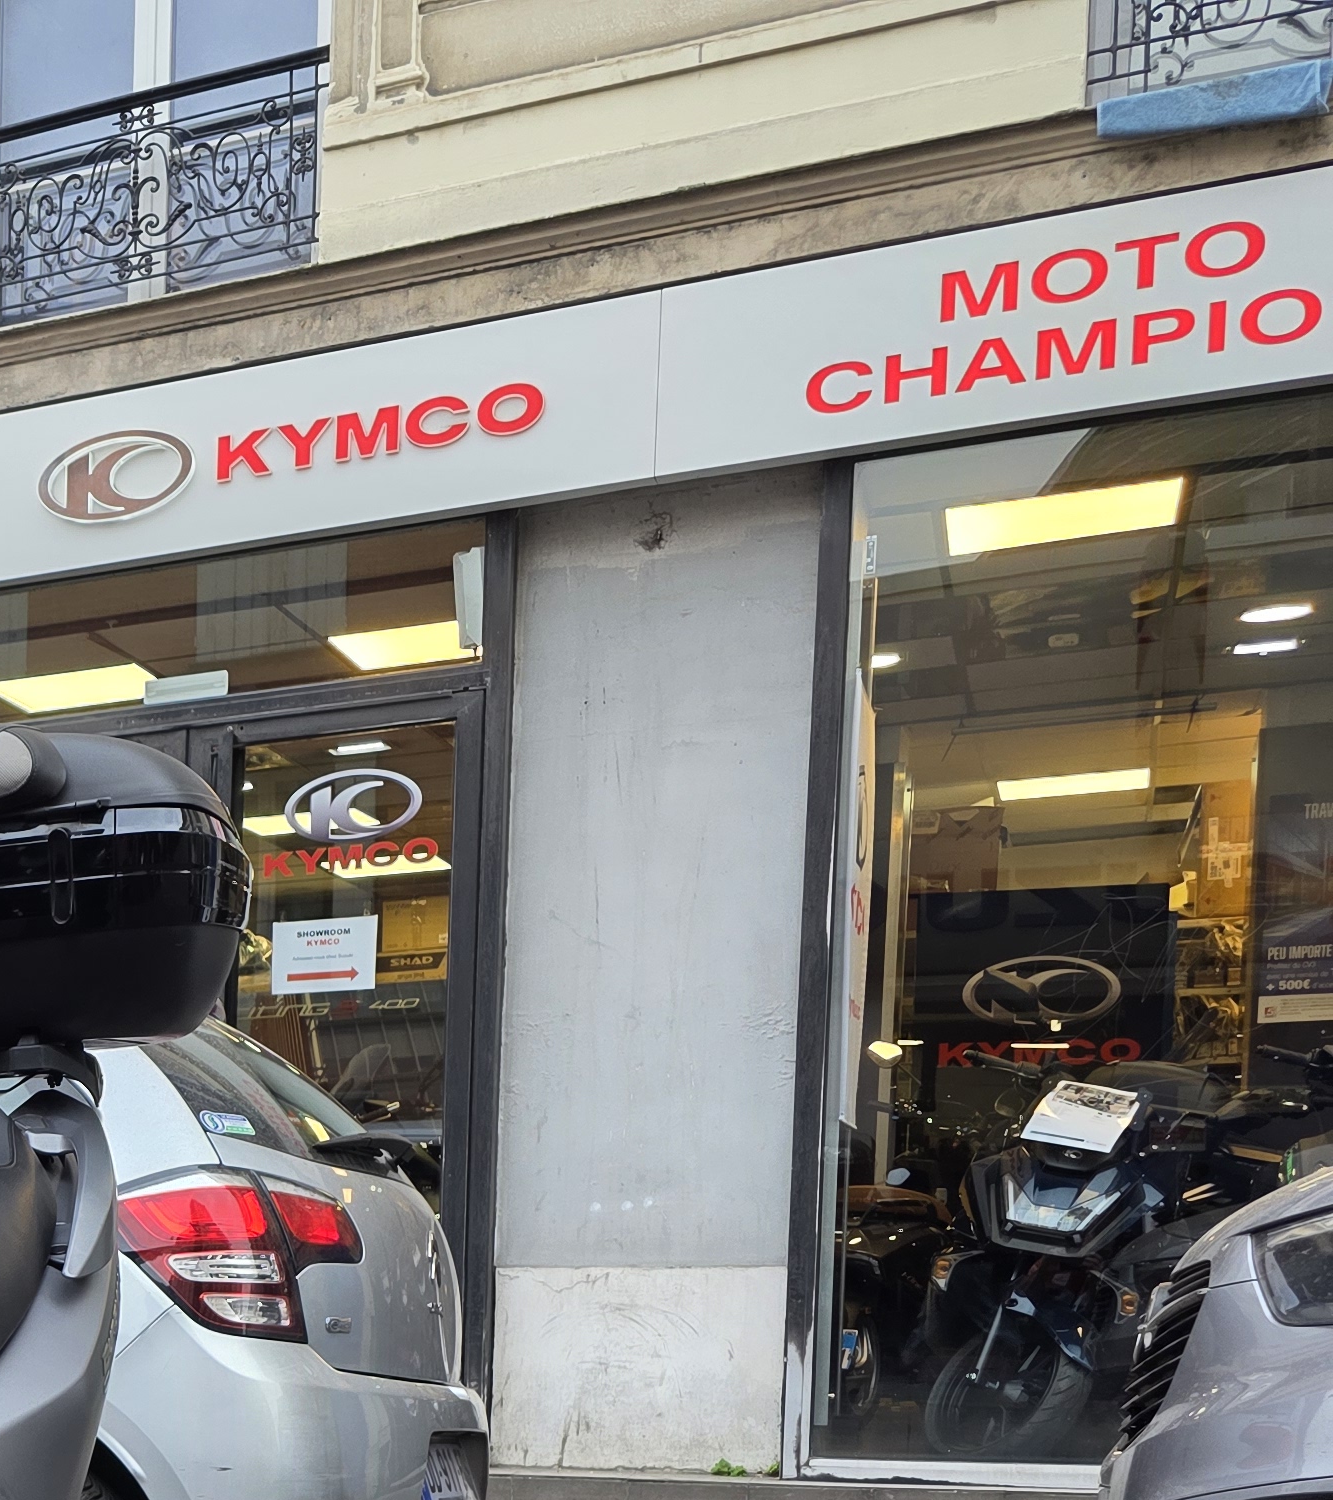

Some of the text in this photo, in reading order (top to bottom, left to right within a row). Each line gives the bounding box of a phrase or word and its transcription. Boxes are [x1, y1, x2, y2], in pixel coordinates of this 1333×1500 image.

[939, 221, 1266, 323] MOTO
[805, 288, 1323, 414] CHAMPIO
[216, 382, 545, 483] KYMCO
[263, 836, 439, 879] KYMCO
[296, 927, 351, 938] SHOWROOM
[306, 938, 340, 947] KYMCO
[1267, 944, 1333, 960] PEU IMPORTE
[390, 955, 434, 967] SHAD
[1278, 979, 1311, 991] 500€
[368, 998, 420, 1010] 400
[937, 1037, 1142, 1068] KYMCO
